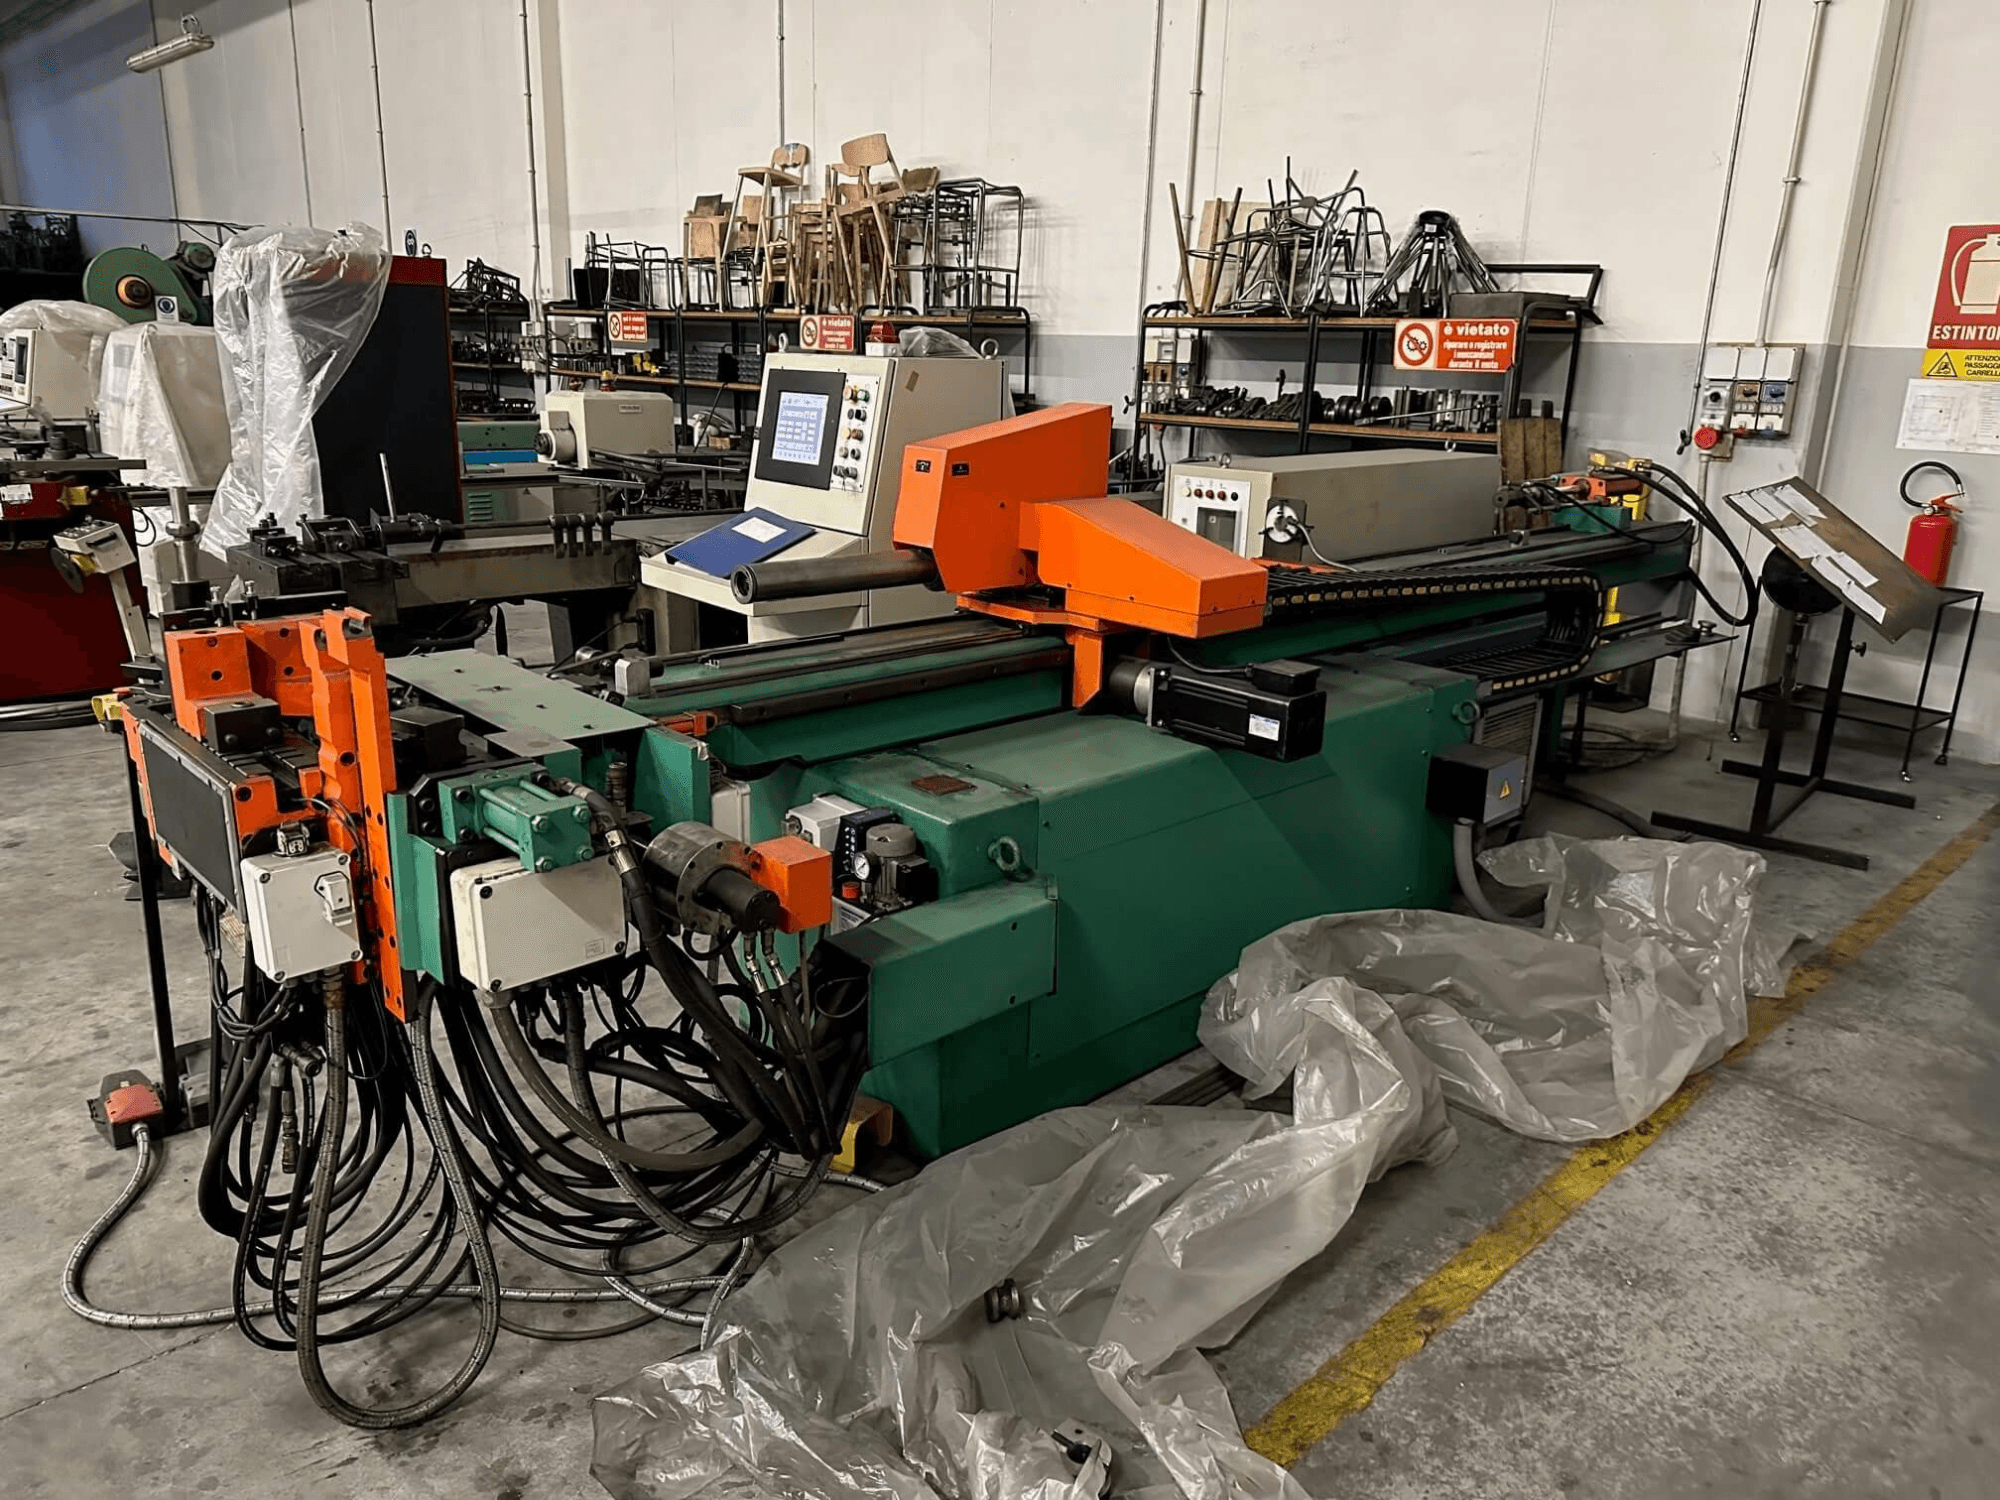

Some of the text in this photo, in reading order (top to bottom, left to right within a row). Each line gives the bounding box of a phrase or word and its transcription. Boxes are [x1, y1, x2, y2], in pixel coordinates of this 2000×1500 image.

[1443, 321, 1510, 336] è vietato
[1964, 361, 2000, 369] PASSAGG
